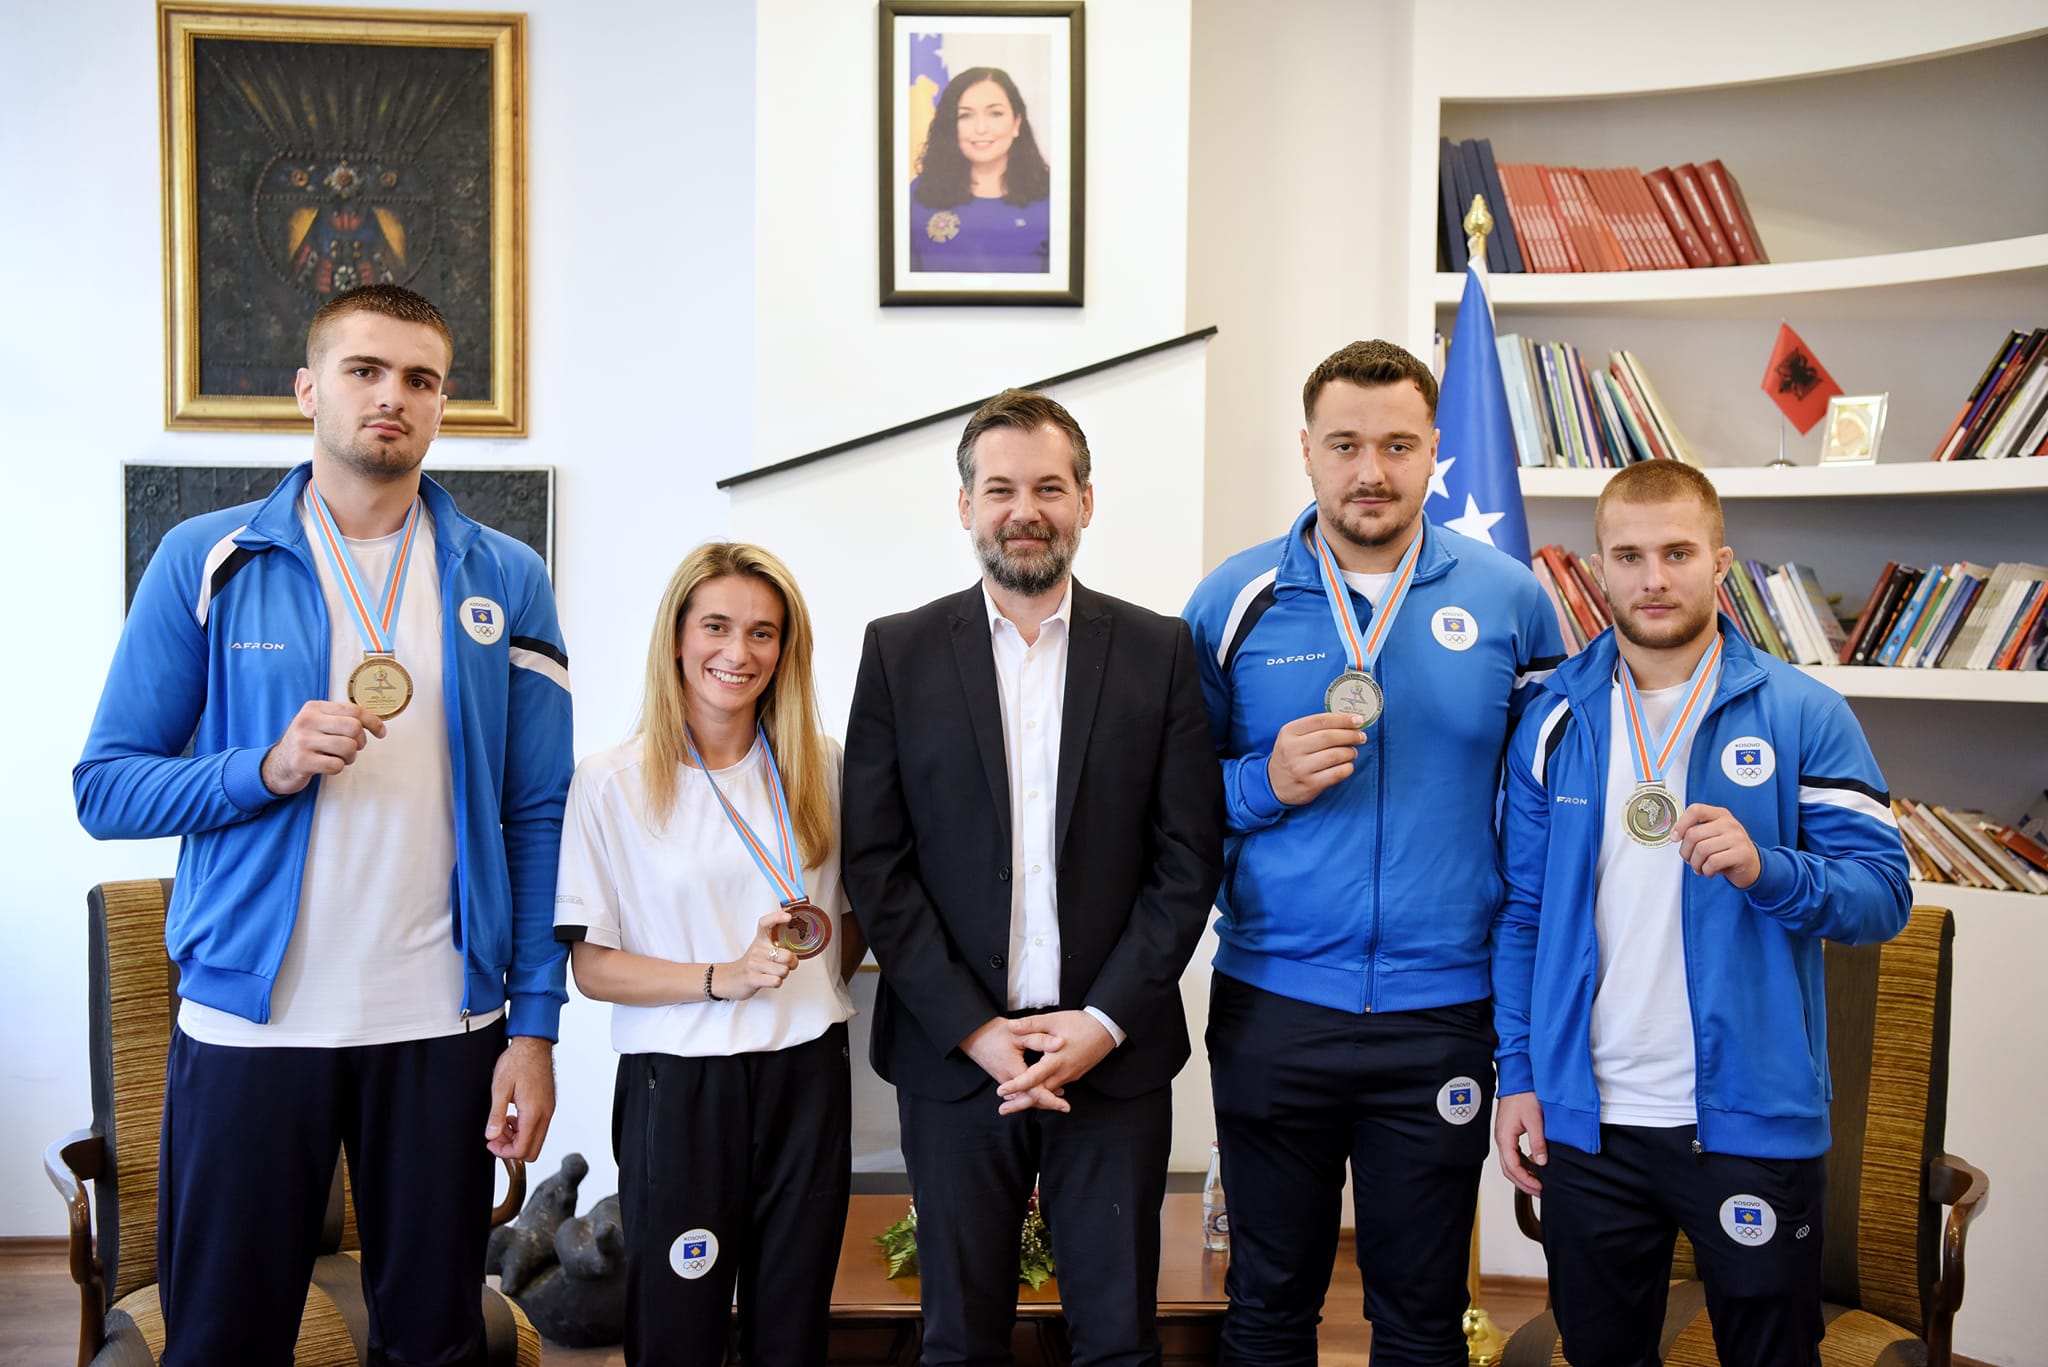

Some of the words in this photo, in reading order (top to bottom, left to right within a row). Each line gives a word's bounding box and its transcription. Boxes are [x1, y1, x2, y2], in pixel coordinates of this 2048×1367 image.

[231, 642, 285, 650] AFRON
[1266, 652, 1326, 666] DAFRON
[1556, 796, 1588, 805] FRON
[1449, 1081, 1471, 1089] KOSOVO
[1733, 1199, 1760, 1208] KOSOVO
